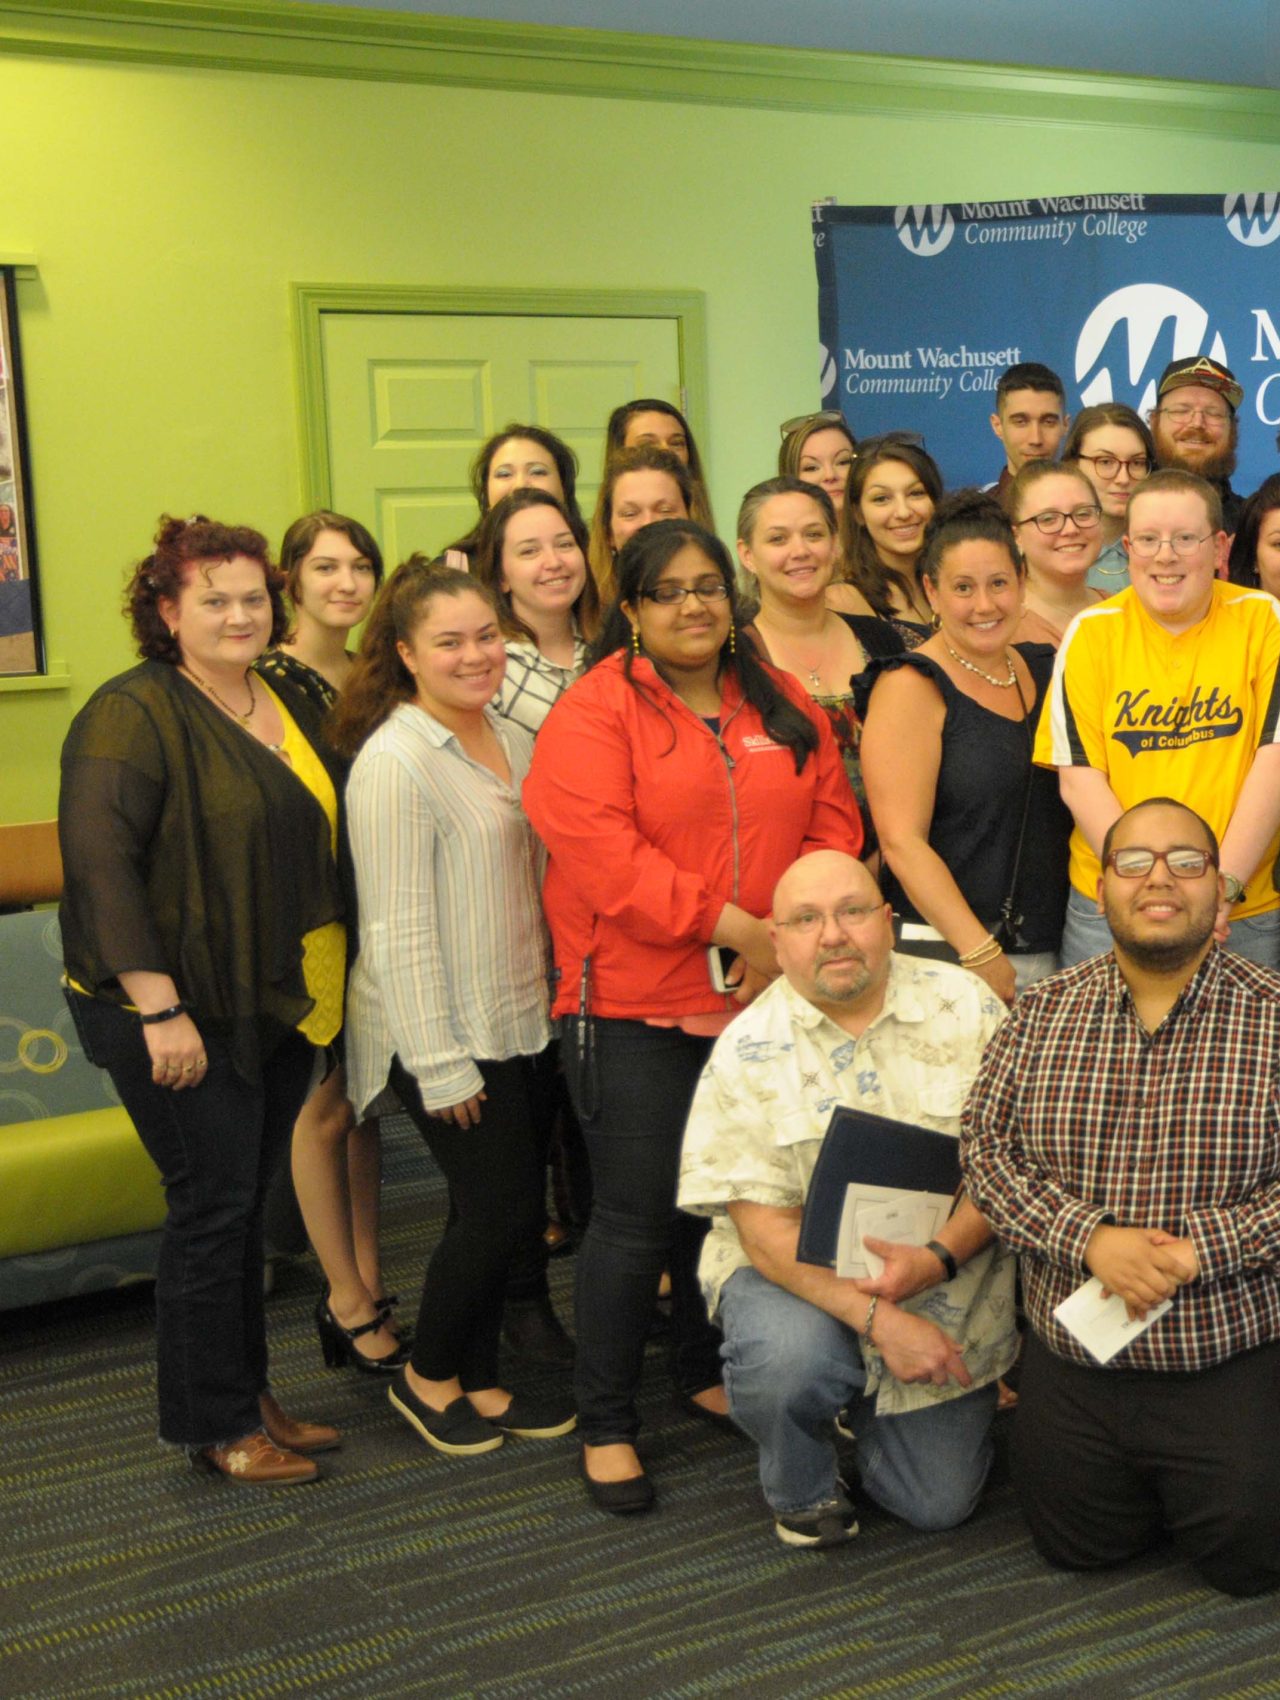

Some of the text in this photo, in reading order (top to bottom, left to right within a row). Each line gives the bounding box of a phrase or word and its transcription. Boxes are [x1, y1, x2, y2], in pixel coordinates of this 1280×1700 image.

[961, 193, 1145, 220] Mount Wachusett
[965, 212, 1147, 245] Community College
[844, 345, 1022, 370] Mount Wachusett
[846, 371, 952, 400] Community
[1114, 686, 1233, 733] Knights
[1141, 728, 1214, 748] of Columbus
